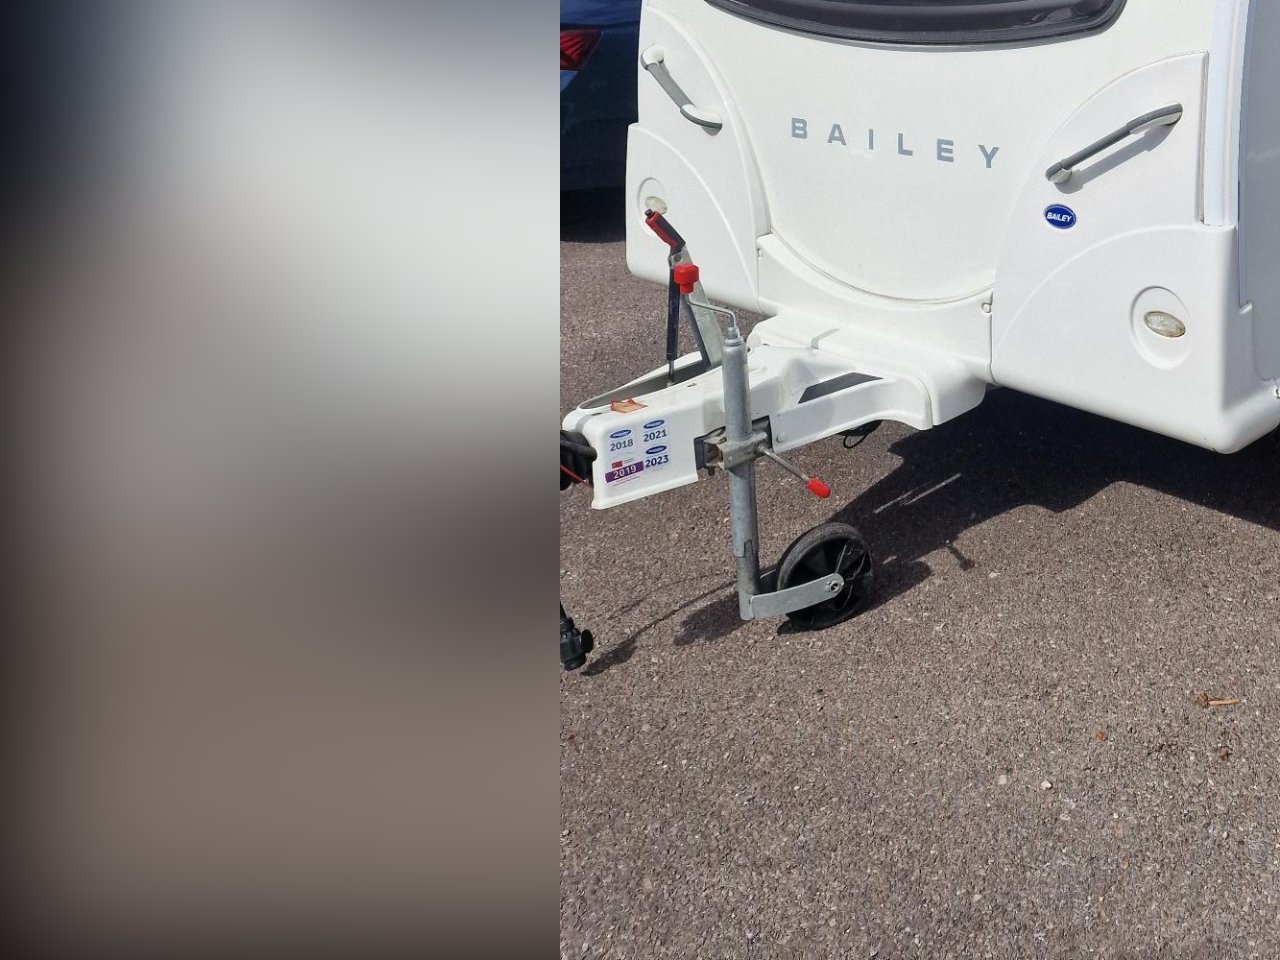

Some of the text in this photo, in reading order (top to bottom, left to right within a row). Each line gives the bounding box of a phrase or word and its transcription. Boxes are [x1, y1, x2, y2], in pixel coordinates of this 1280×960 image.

[791, 117, 1000, 169] BAILEY
[1046, 212, 1073, 223] BAILEY
[643, 429, 668, 442] 2021
[610, 438, 634, 451] 2018
[645, 454, 669, 468] 2023
[613, 465, 637, 479] 2019
